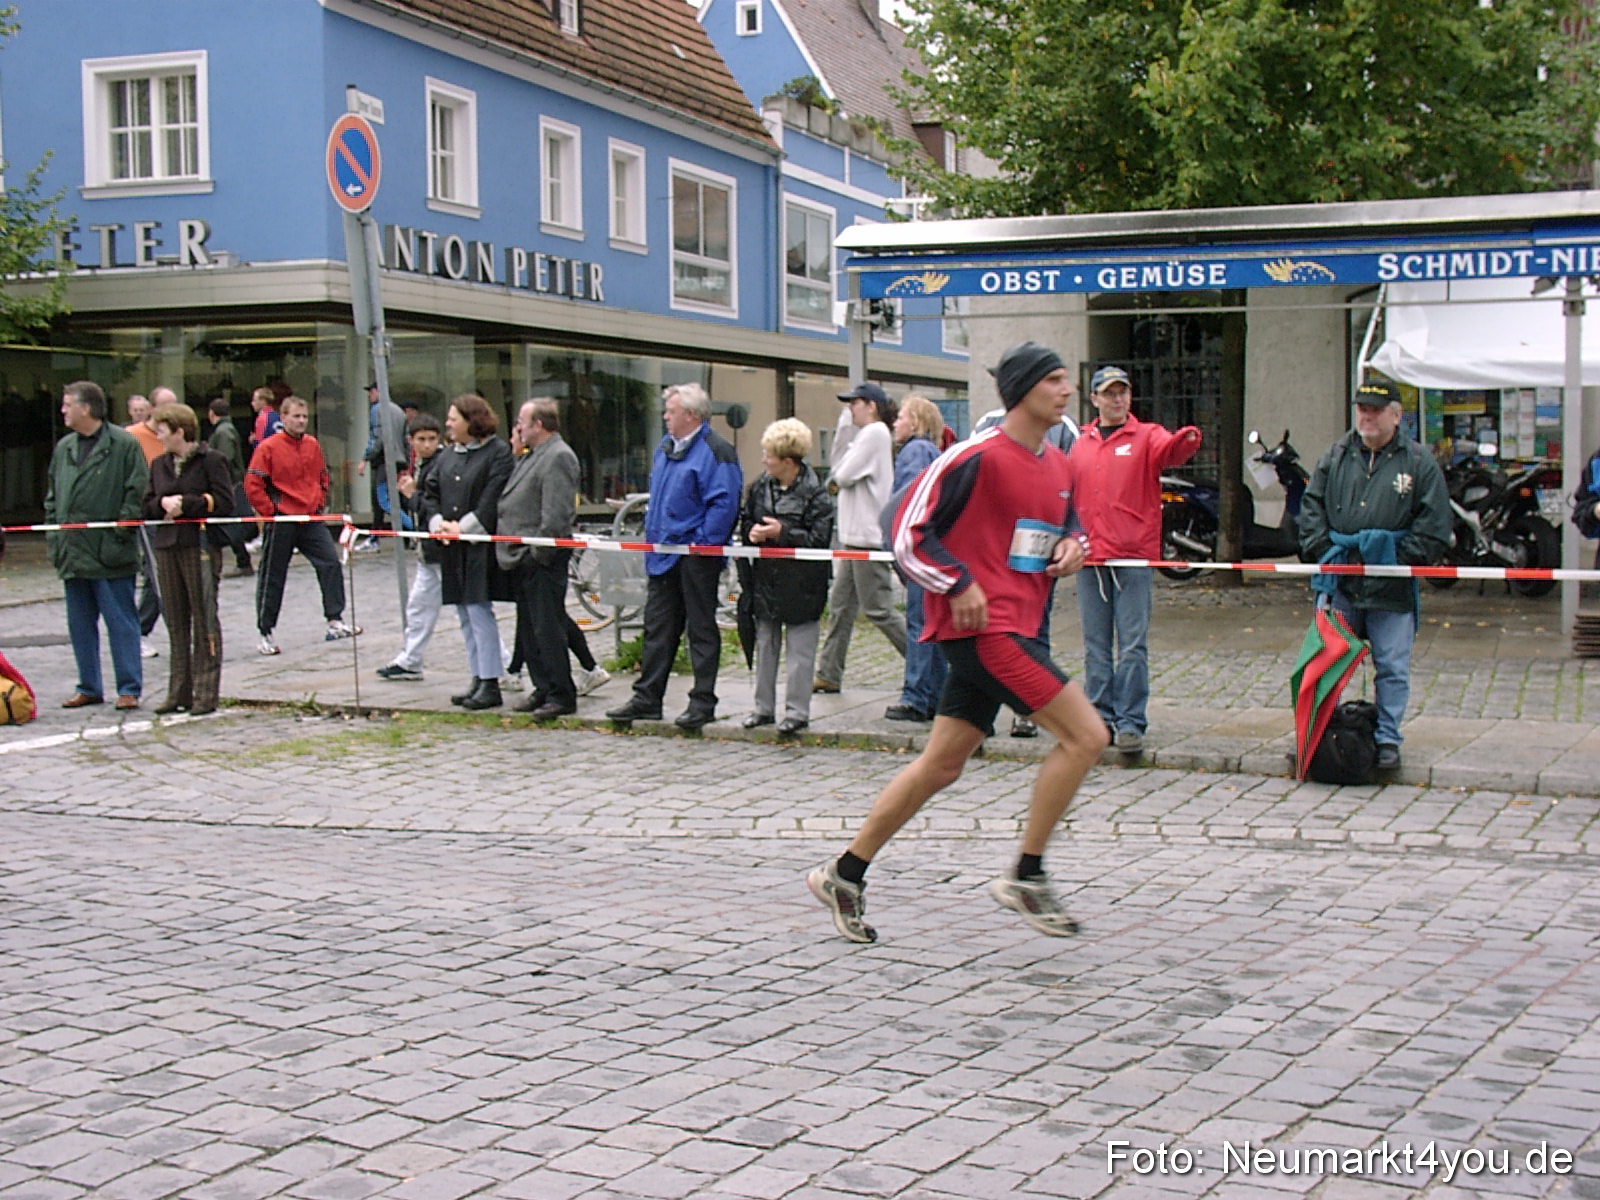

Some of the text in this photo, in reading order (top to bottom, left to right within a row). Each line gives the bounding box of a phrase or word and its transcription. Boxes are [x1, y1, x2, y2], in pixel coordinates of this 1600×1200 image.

[54, 219, 214, 269] ETER
[376, 223, 605, 302] NTON PETER
[980, 261, 1227, 293] OBST GEMÜSE
